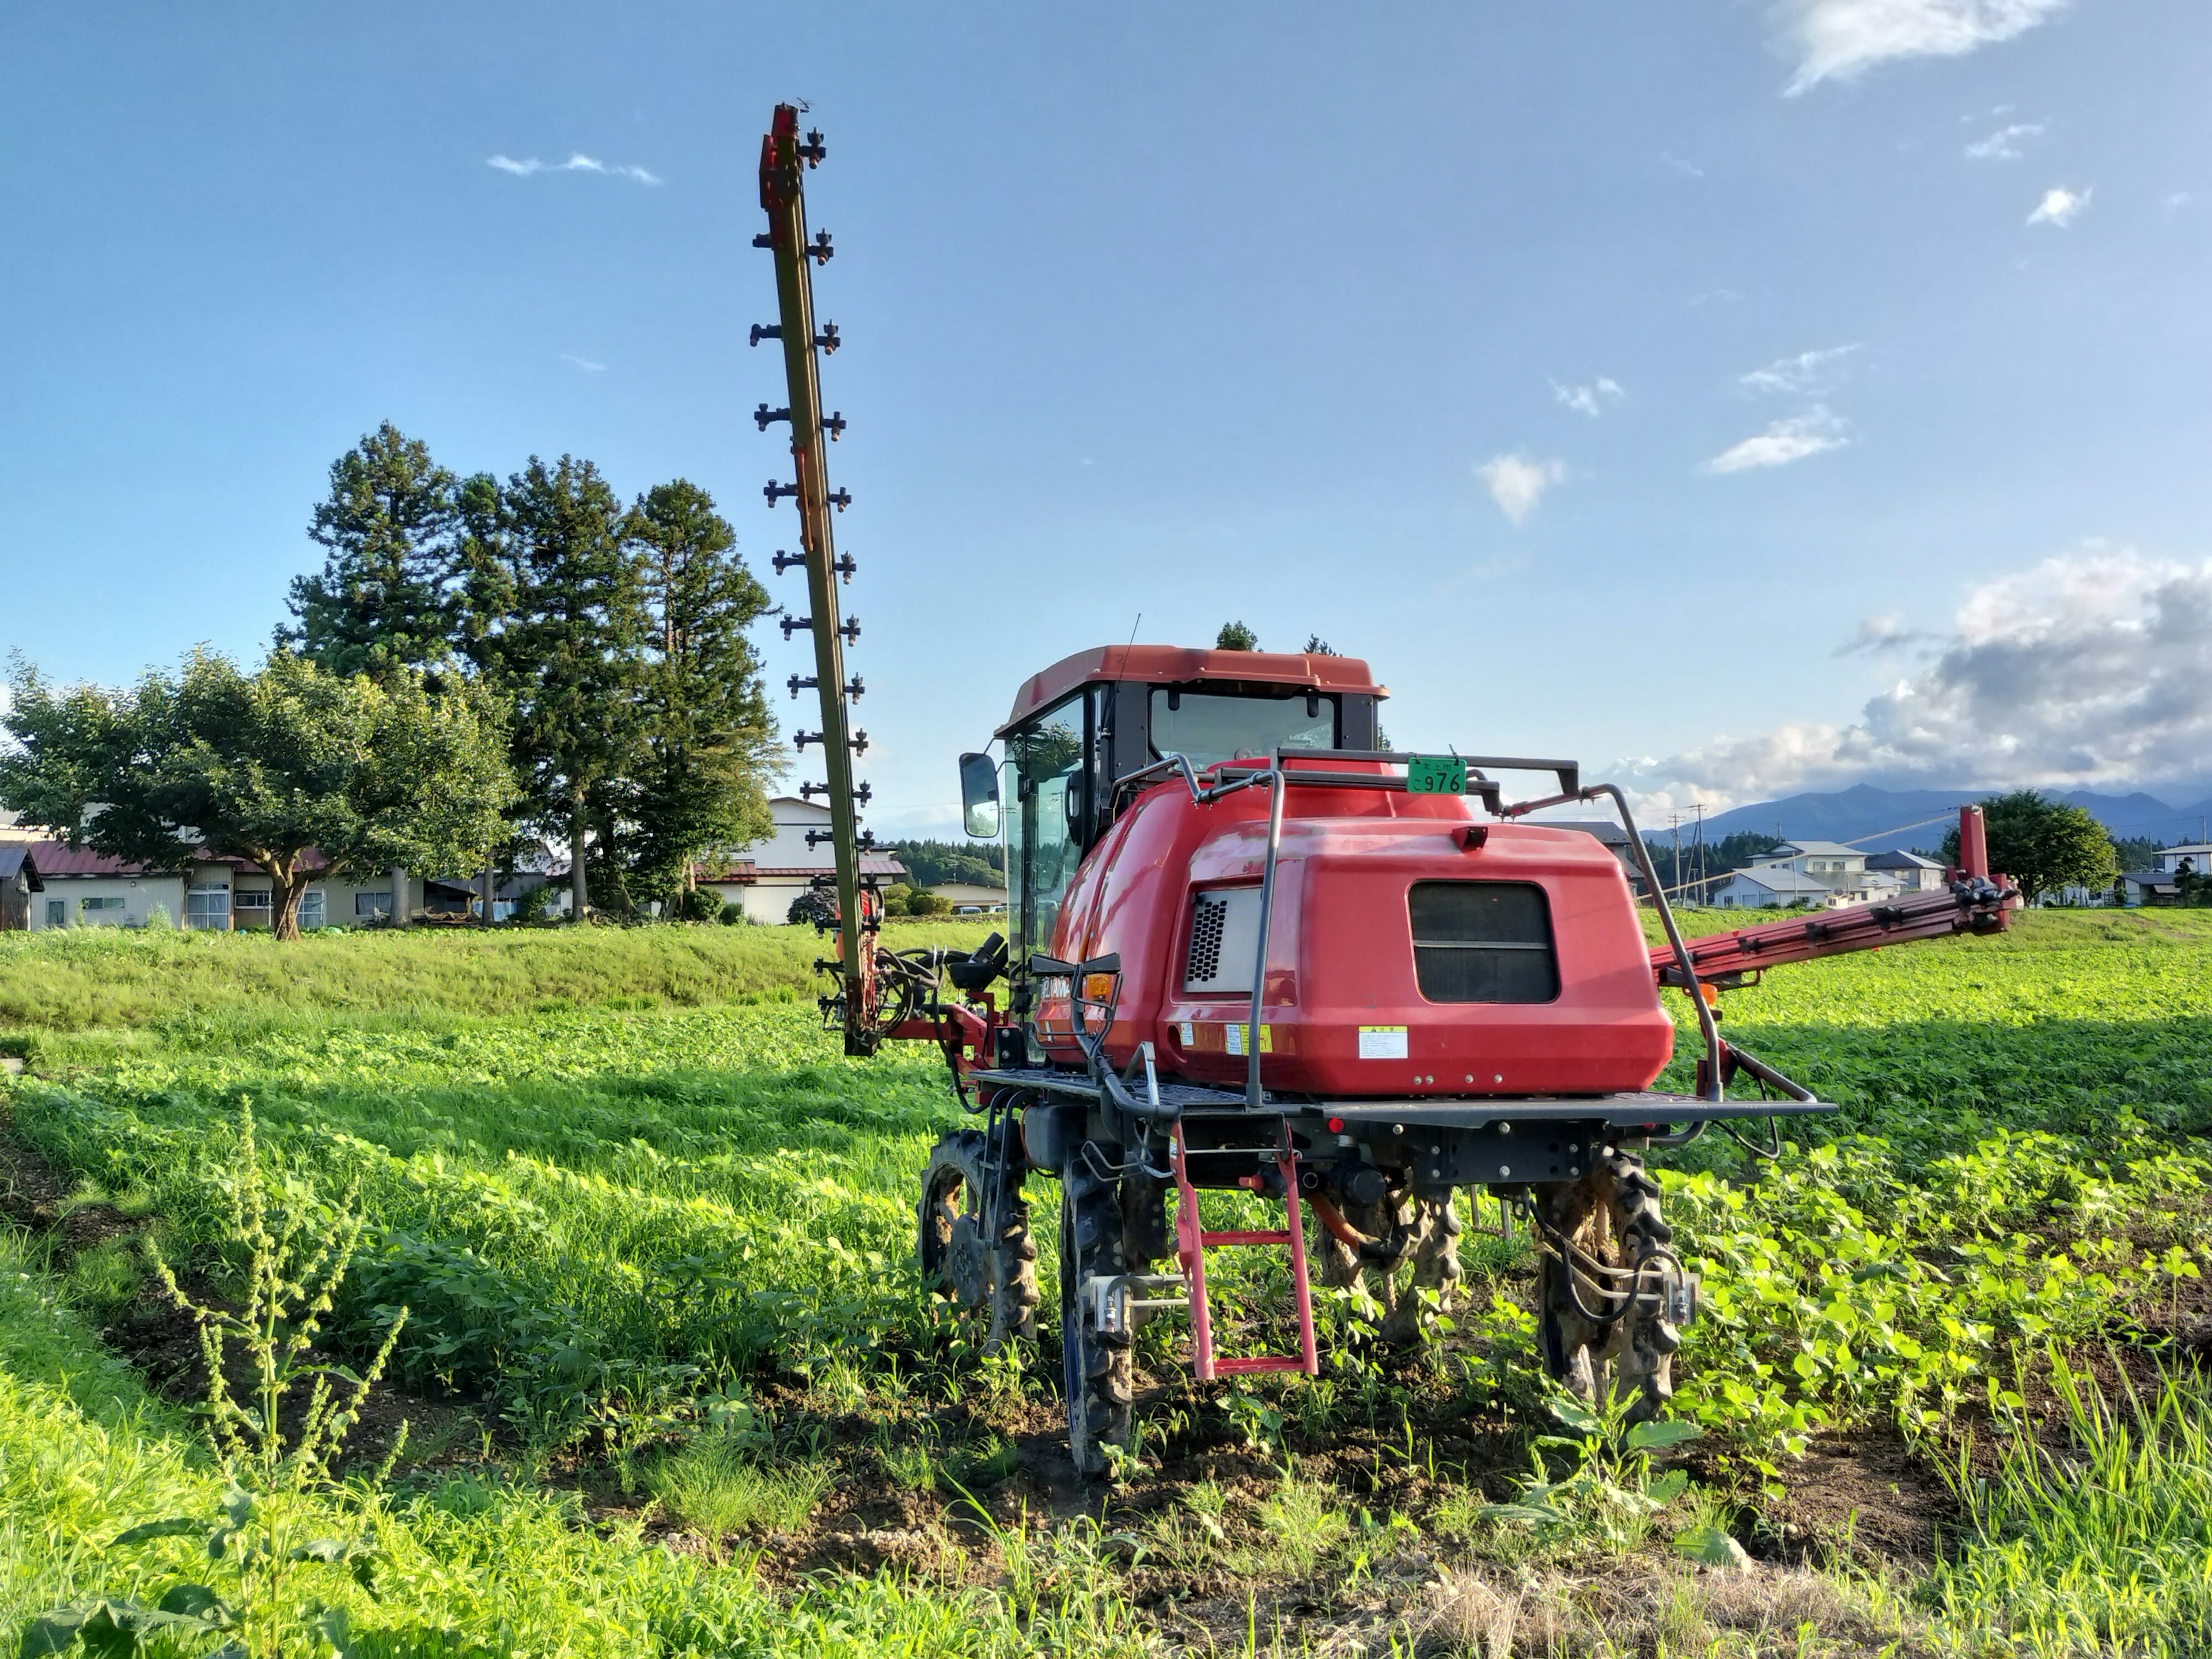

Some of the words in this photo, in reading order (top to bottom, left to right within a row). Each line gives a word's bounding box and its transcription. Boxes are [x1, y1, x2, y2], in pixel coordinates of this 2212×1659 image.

[1423, 762, 1451, 771] 北上市
[1425, 772, 1460, 793] 976
